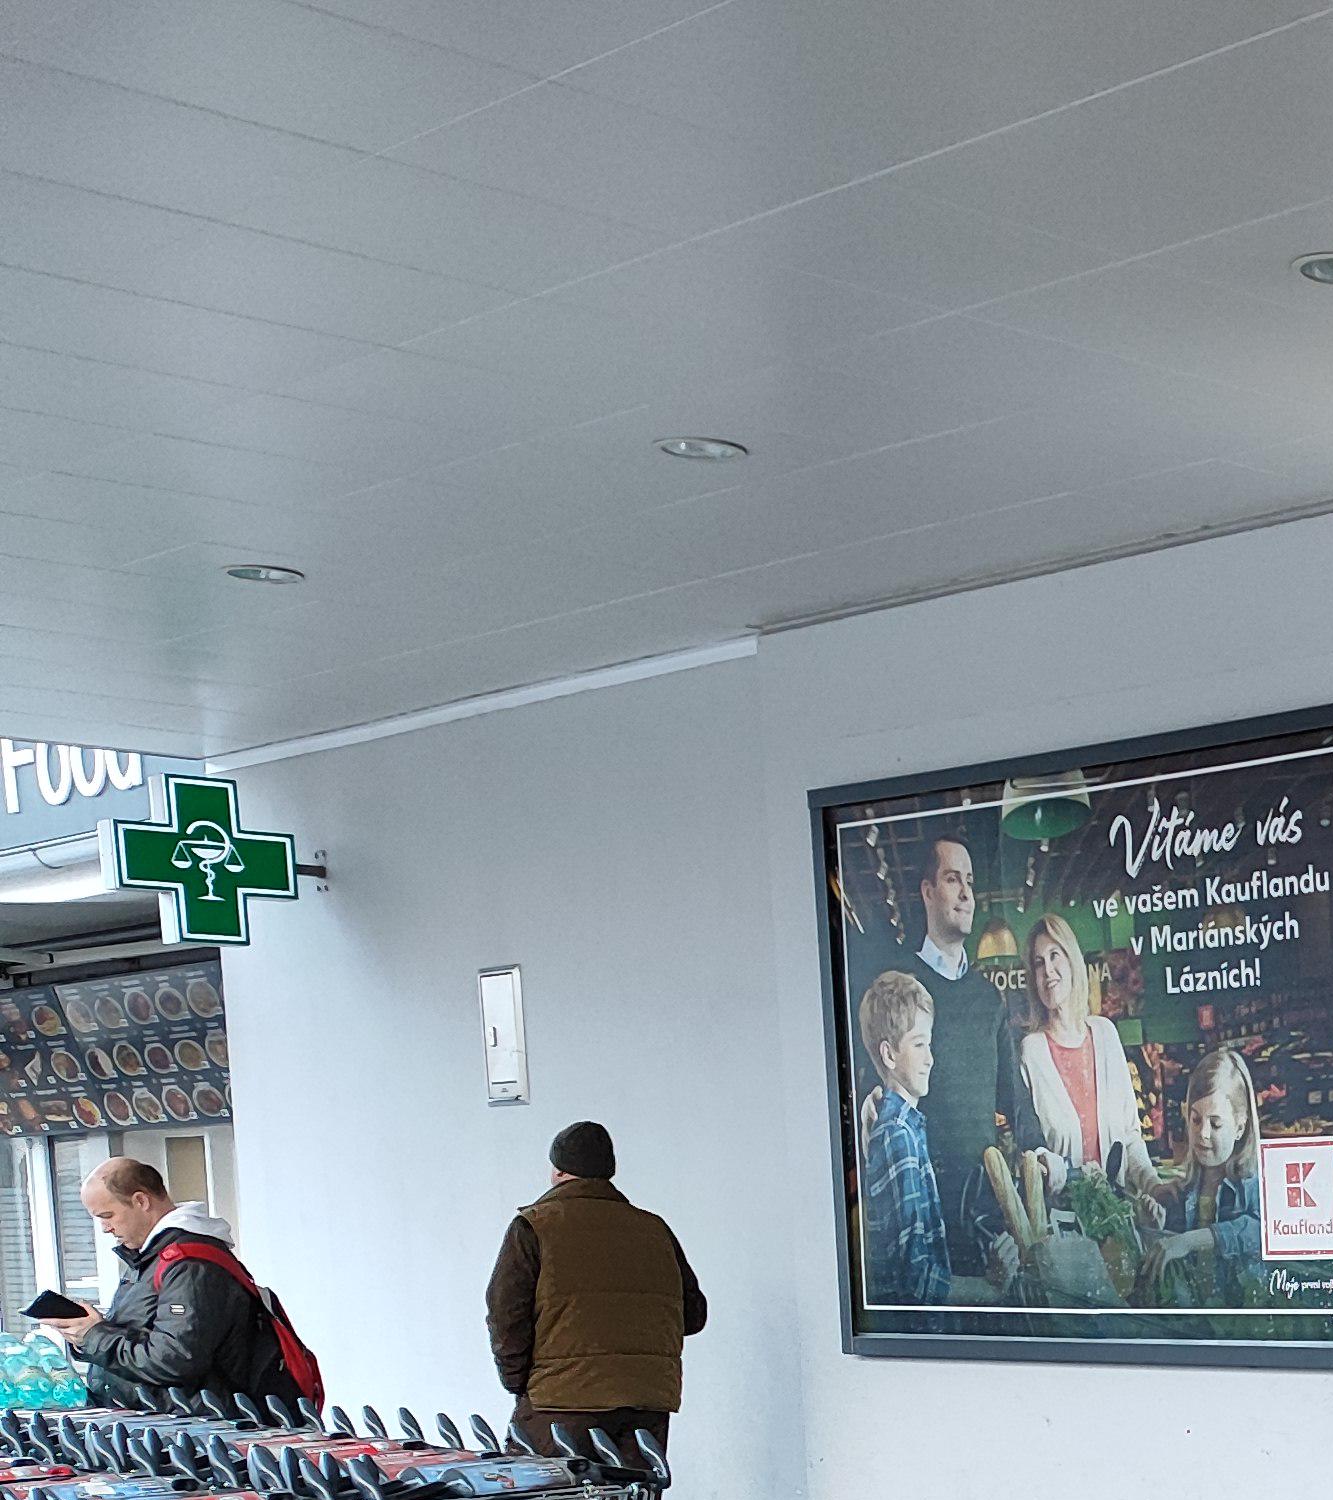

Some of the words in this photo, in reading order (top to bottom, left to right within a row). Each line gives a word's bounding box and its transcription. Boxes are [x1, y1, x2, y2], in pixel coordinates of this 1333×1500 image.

[1109, 797, 1246, 879] Vítáme
[1256, 796, 1304, 846] vás
[1093, 898, 1119, 918] ve
[1125, 884, 1199, 914] vašem
[1205, 864, 1330, 906] Kauflandu
[1130, 935, 1144, 956] v
[1150, 911, 1300, 954] Mariánských
[1165, 958, 1262, 994] Lázních!
[1273, 1219, 1333, 1236] Kaufland
